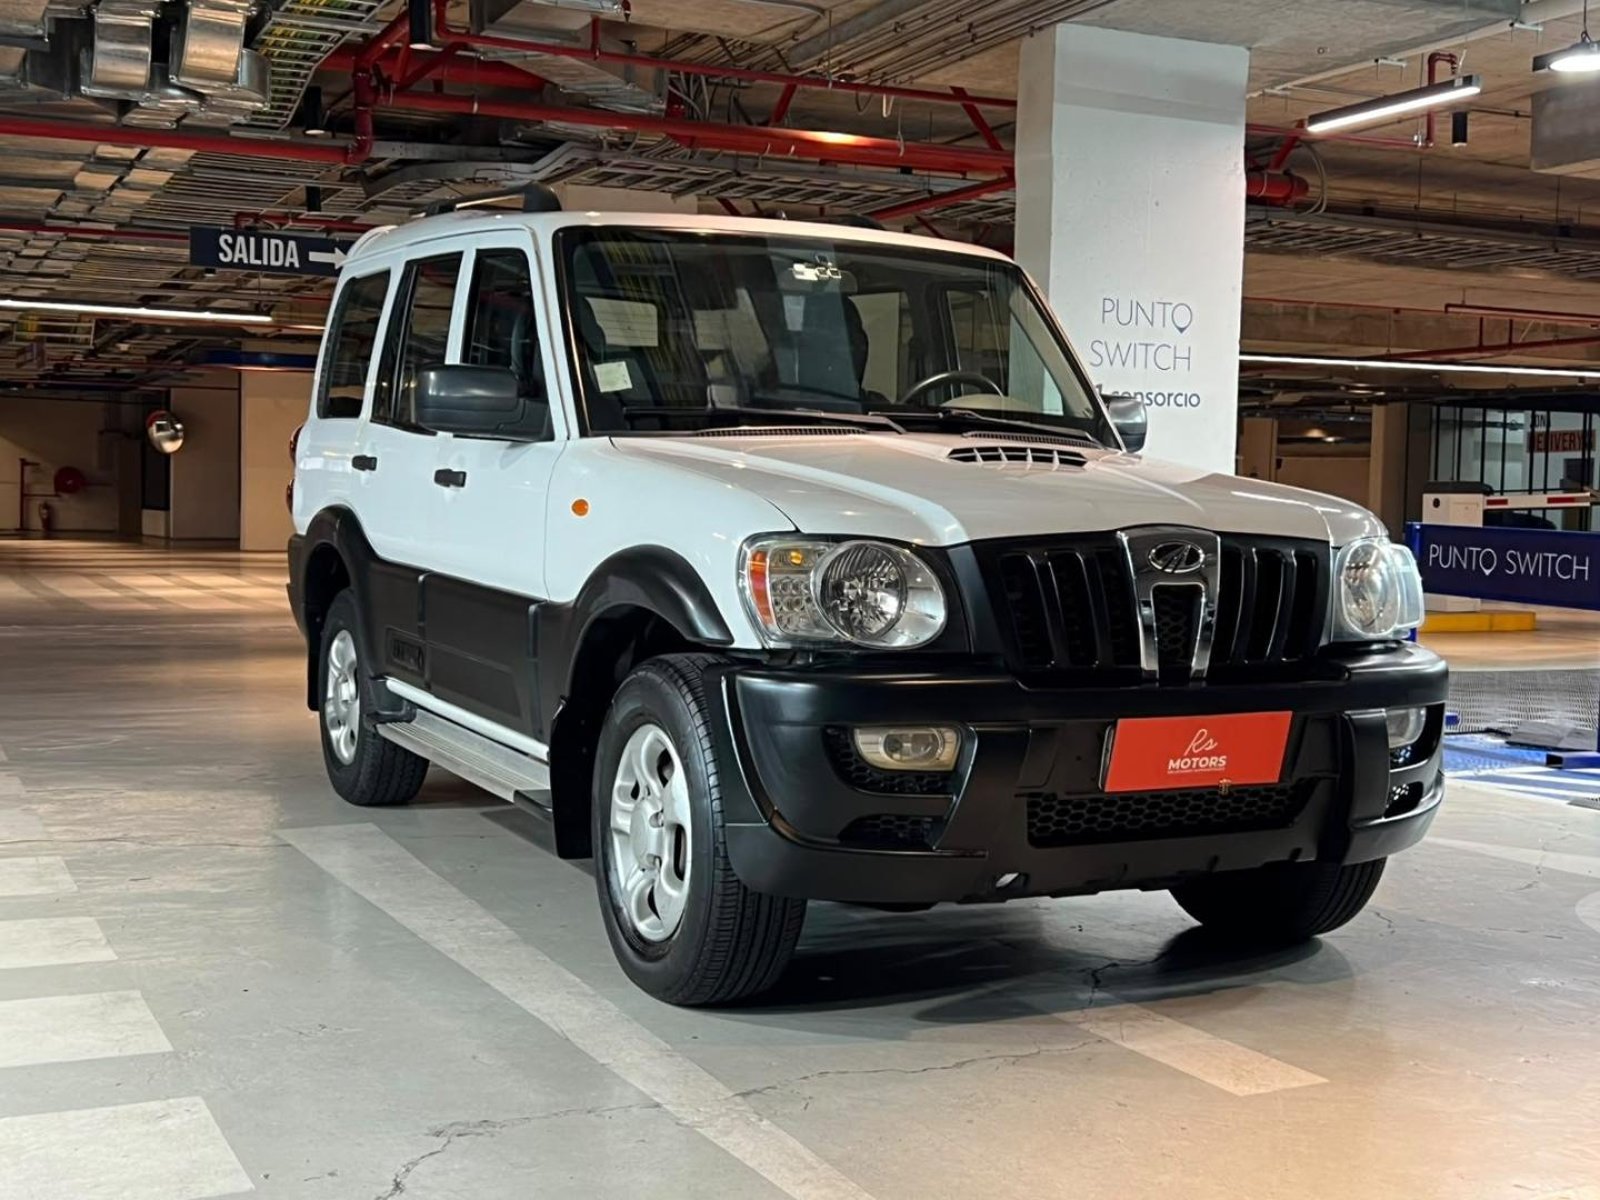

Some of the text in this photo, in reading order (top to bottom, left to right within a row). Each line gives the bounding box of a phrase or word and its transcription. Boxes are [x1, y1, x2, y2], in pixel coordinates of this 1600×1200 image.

[218, 234, 300, 268] SALIDA
[1101, 297, 1193, 334] PUNTO
[1089, 339, 1191, 372] SWITCH
[1529, 432, 1585, 452] EIVERY
[1428, 543, 1590, 581] PUNTO SWITCH
[1168, 755, 1227, 770] MOTORS
